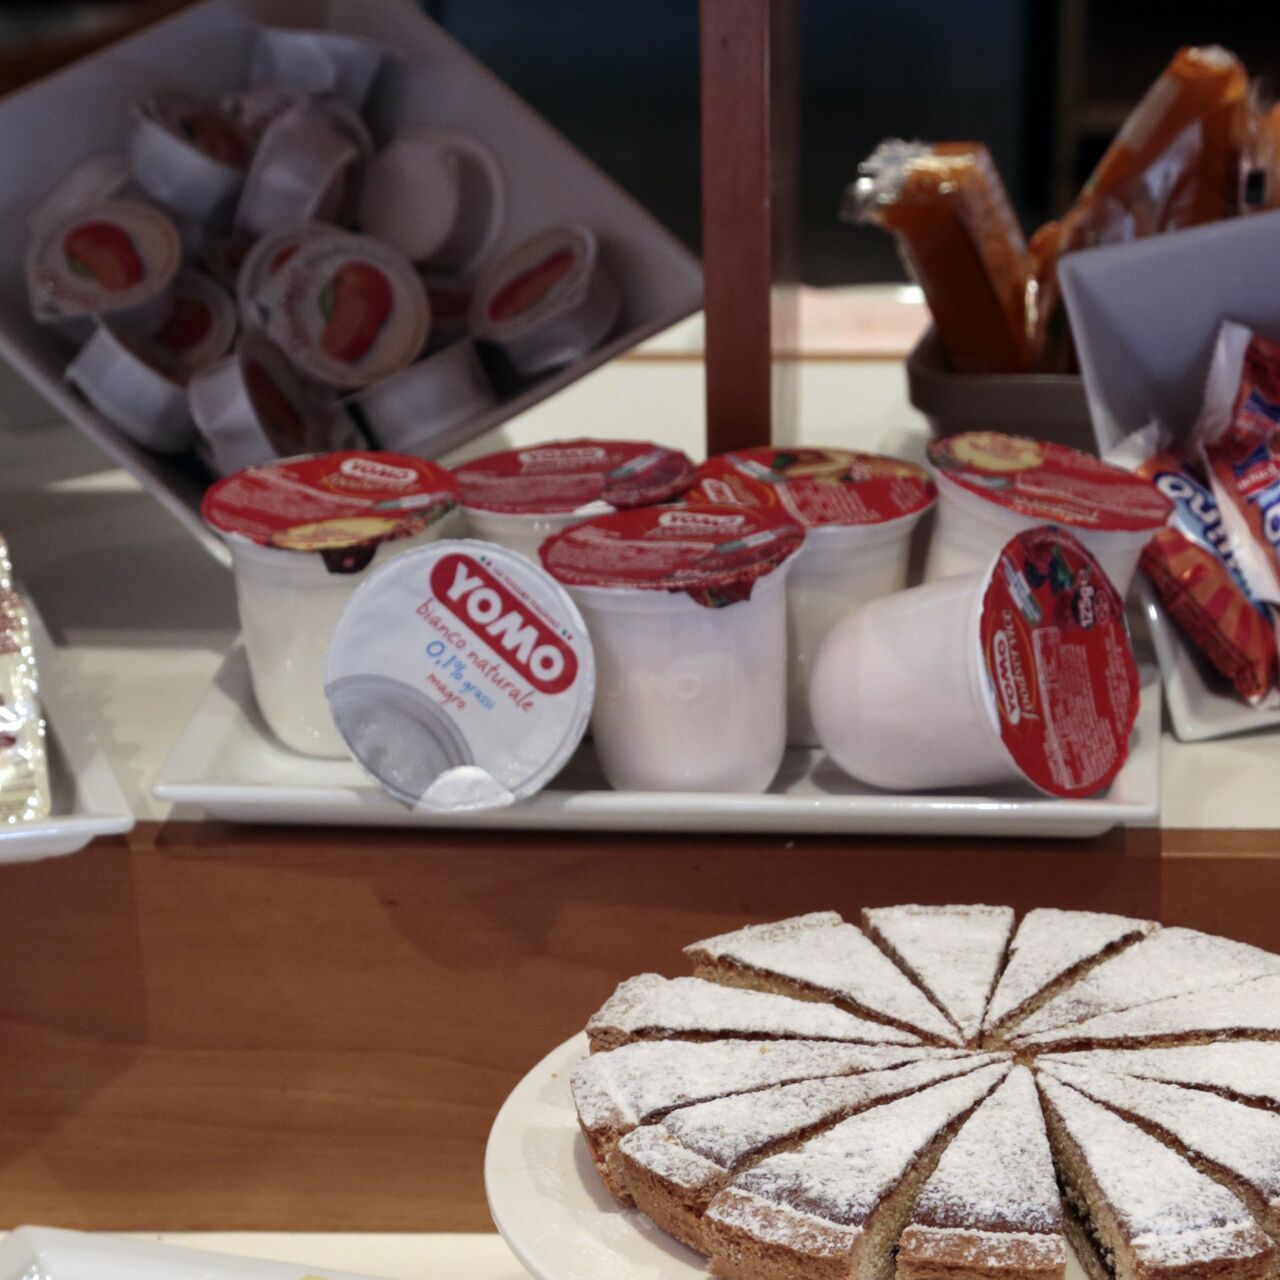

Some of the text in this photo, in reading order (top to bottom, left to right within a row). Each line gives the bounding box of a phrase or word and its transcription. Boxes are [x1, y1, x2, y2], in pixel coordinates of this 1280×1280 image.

[350, 460, 412, 481] YOMO
[415, 596, 535, 711] bianco naturale
[445, 561, 564, 681] YOMO
[425, 640, 496, 710] 0,1% grassi
[426, 672, 466, 710] magro
[998, 639, 1017, 713] YOMO
